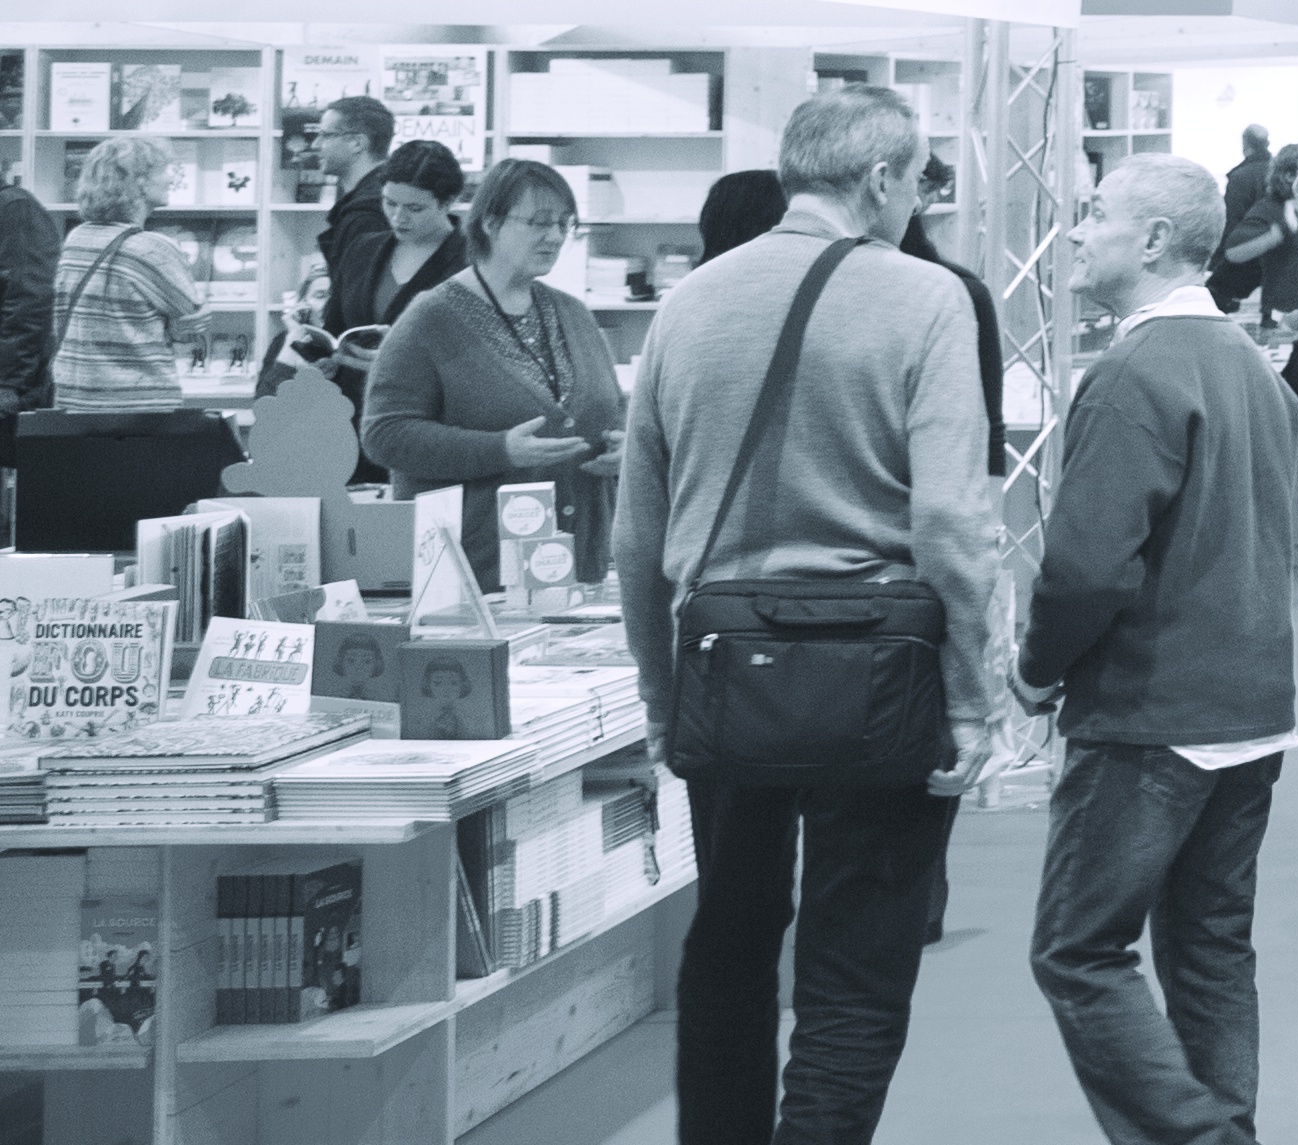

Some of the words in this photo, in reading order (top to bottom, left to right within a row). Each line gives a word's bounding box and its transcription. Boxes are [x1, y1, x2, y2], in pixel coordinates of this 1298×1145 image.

[304, 55, 359, 66] DEMAIN
[35, 623, 144, 639] DICTIONNAIRE
[30, 638, 144, 684] FOU
[213, 660, 234, 677] LA
[235, 662, 300, 682] FABRIQUE
[28, 685, 58, 708] DU
[65, 685, 140, 708] CORPS
[55, 710, 74, 718] KATY
[92, 917, 106, 928] LA
[109, 916, 157, 928] SOURCE
